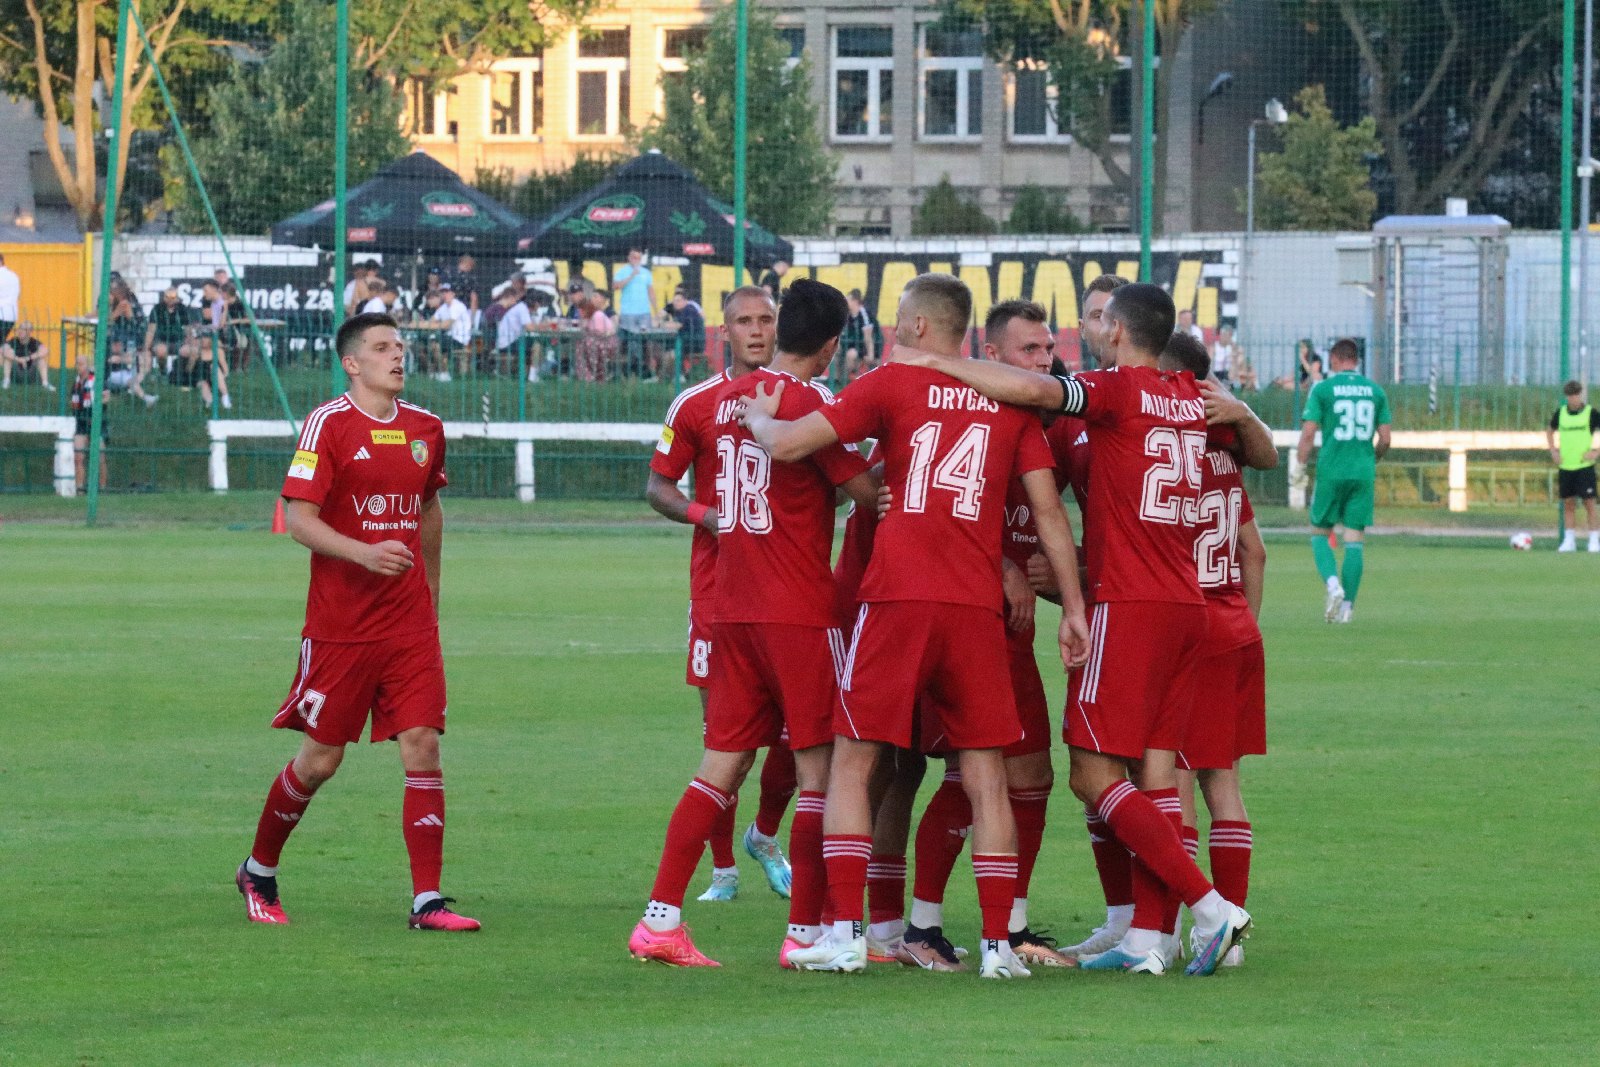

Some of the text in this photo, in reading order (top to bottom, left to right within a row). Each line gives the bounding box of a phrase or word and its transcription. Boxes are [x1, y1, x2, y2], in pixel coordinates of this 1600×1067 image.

[1333, 400, 1375, 441] 39
[903, 421, 991, 522] 14
[1139, 426, 1208, 528] 25
[362, 520, 399, 531] Finance
